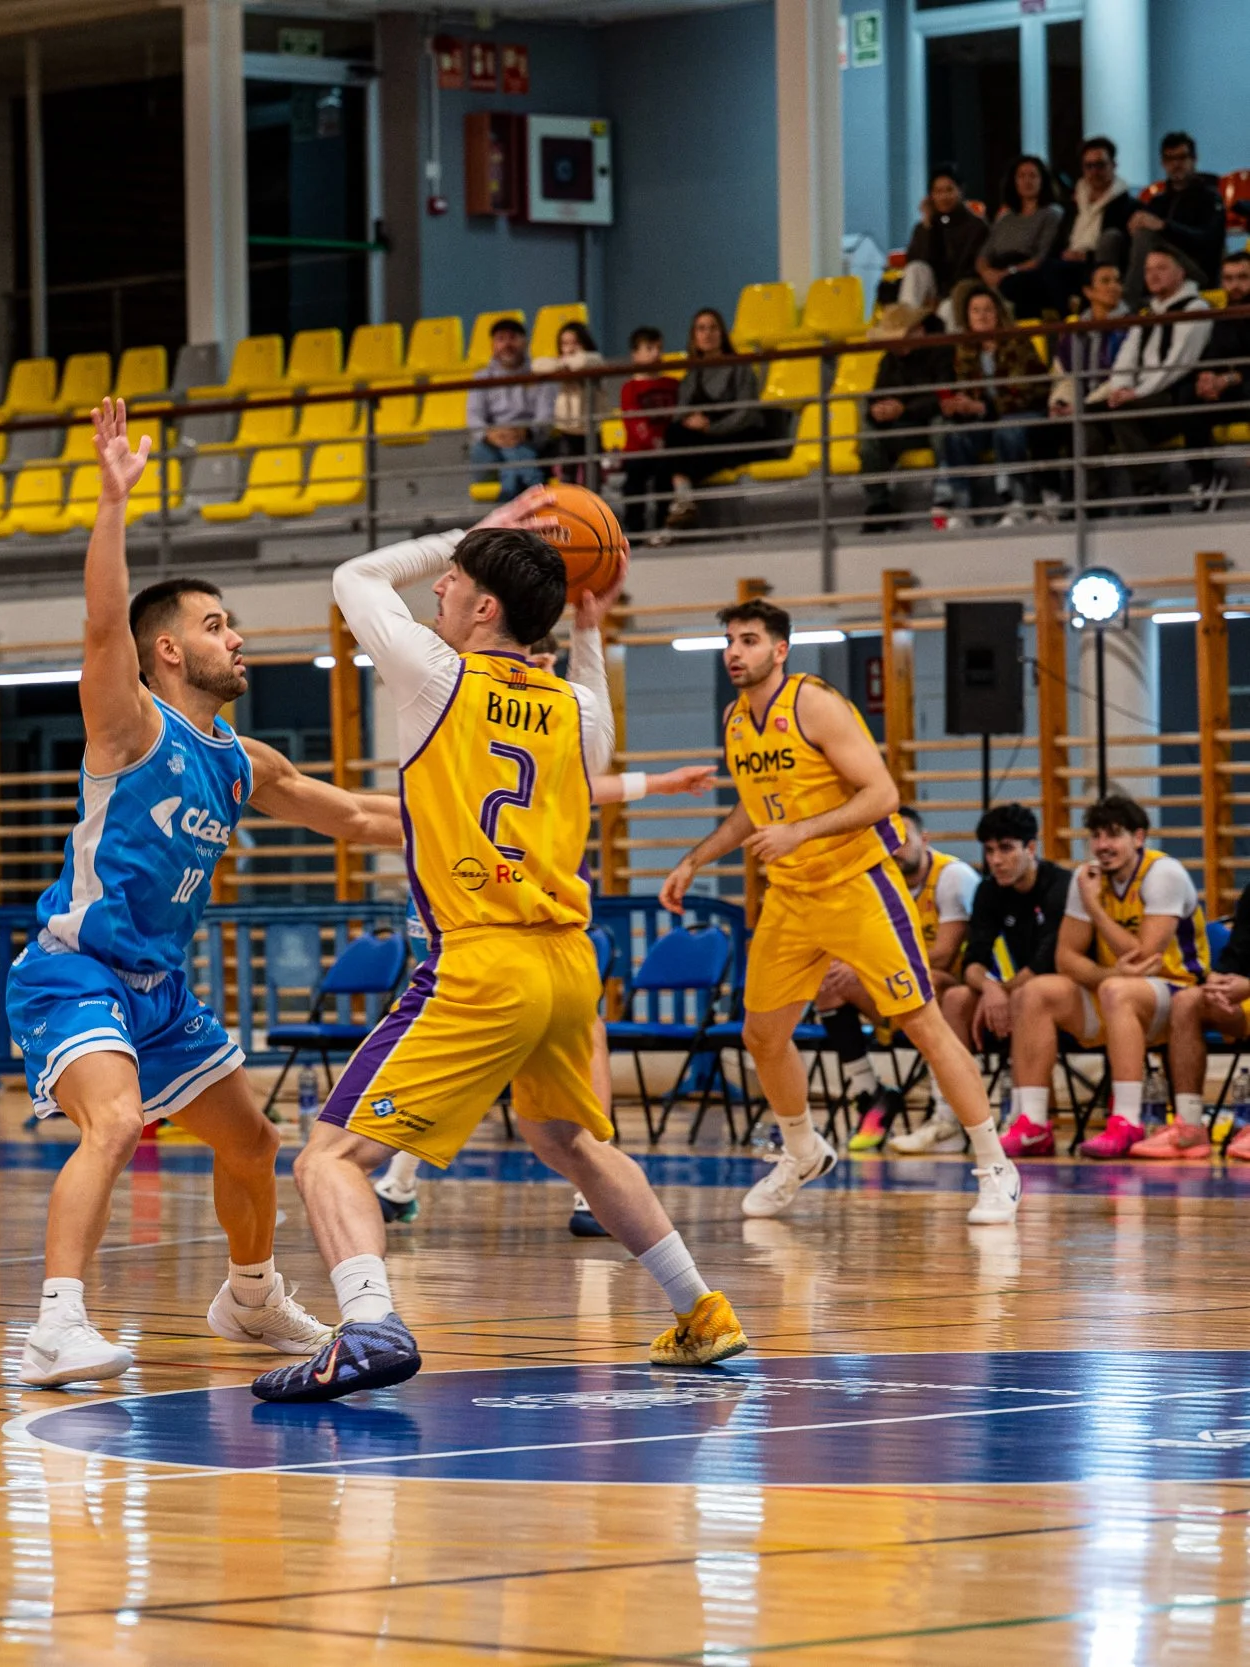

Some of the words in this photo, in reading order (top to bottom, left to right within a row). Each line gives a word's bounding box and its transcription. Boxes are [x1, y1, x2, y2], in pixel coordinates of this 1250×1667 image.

[487, 691, 553, 735] BOIX
[735, 748, 796, 776] HOMS
[478, 740, 538, 862] 2
[762, 792, 786, 821] 15
[170, 866, 205, 903] 10
[883, 969, 914, 1001] 15
